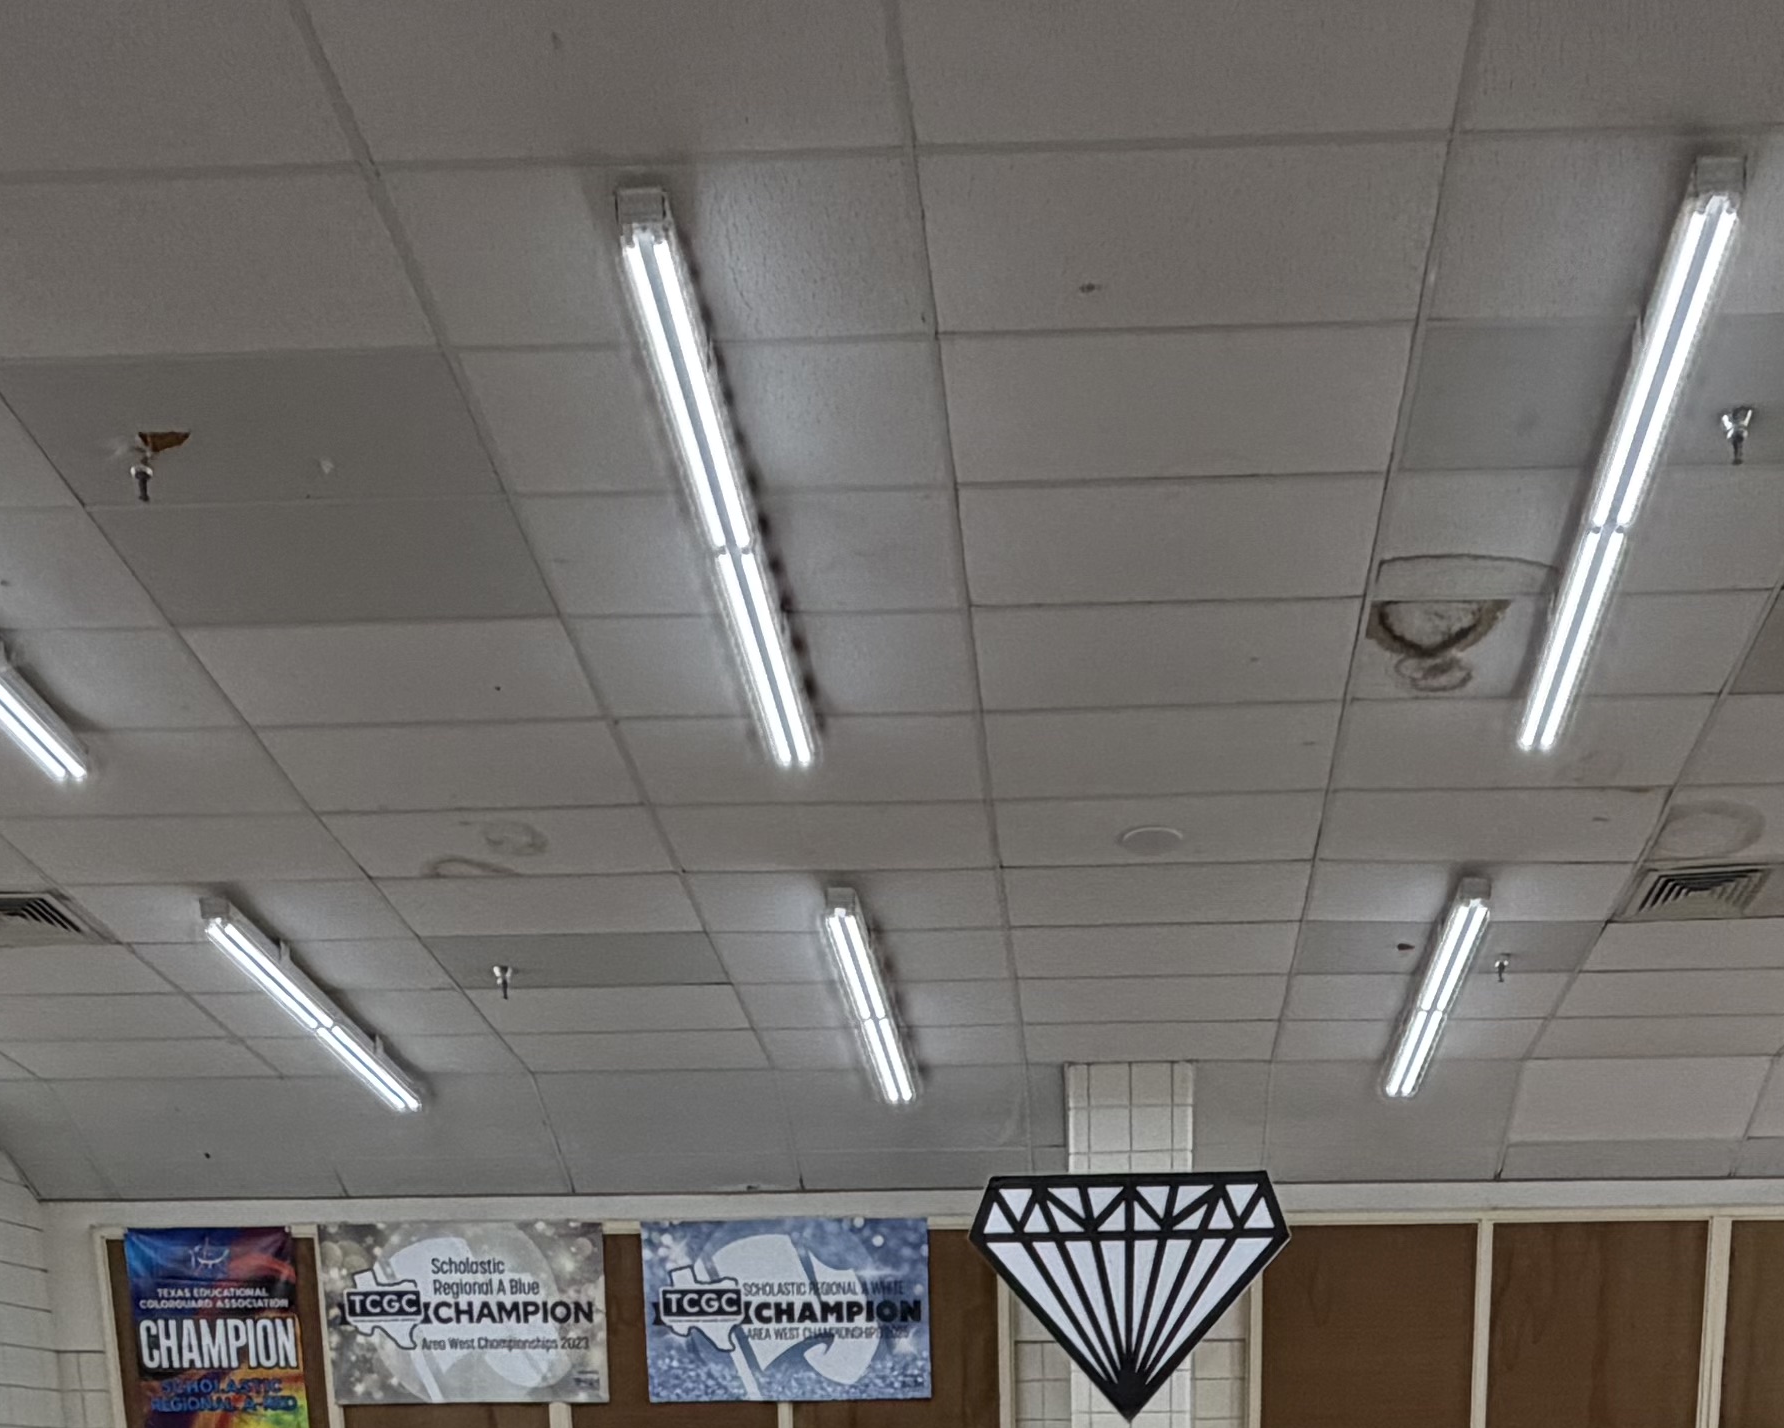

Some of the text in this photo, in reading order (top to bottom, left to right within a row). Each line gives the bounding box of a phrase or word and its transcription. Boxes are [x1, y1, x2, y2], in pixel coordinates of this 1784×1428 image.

[431, 1257, 505, 1275] Scholastic
[157, 1287, 268, 1298] TEXAS EDUCATIONAL
[433, 1279, 540, 1299] Regional A Blue
[742, 1282, 806, 1296] SCHOLASTIC
[809, 1282, 858, 1296] REGIONAL
[139, 1299, 289, 1309] COLORGUARD ASSOCIATION
[349, 1294, 418, 1313] TCGC
[666, 1293, 738, 1313] TCGC
[433, 1301, 594, 1324] CHAMPION
[754, 1301, 921, 1324] CHAMPION
[747, 1328, 772, 1340] AREA
[774, 1328, 799, 1340] WEST
[139, 1318, 297, 1369] CHAMPION
[422, 1338, 446, 1350] Area
[448, 1338, 475, 1350] West
[478, 1337, 558, 1352] Championships
